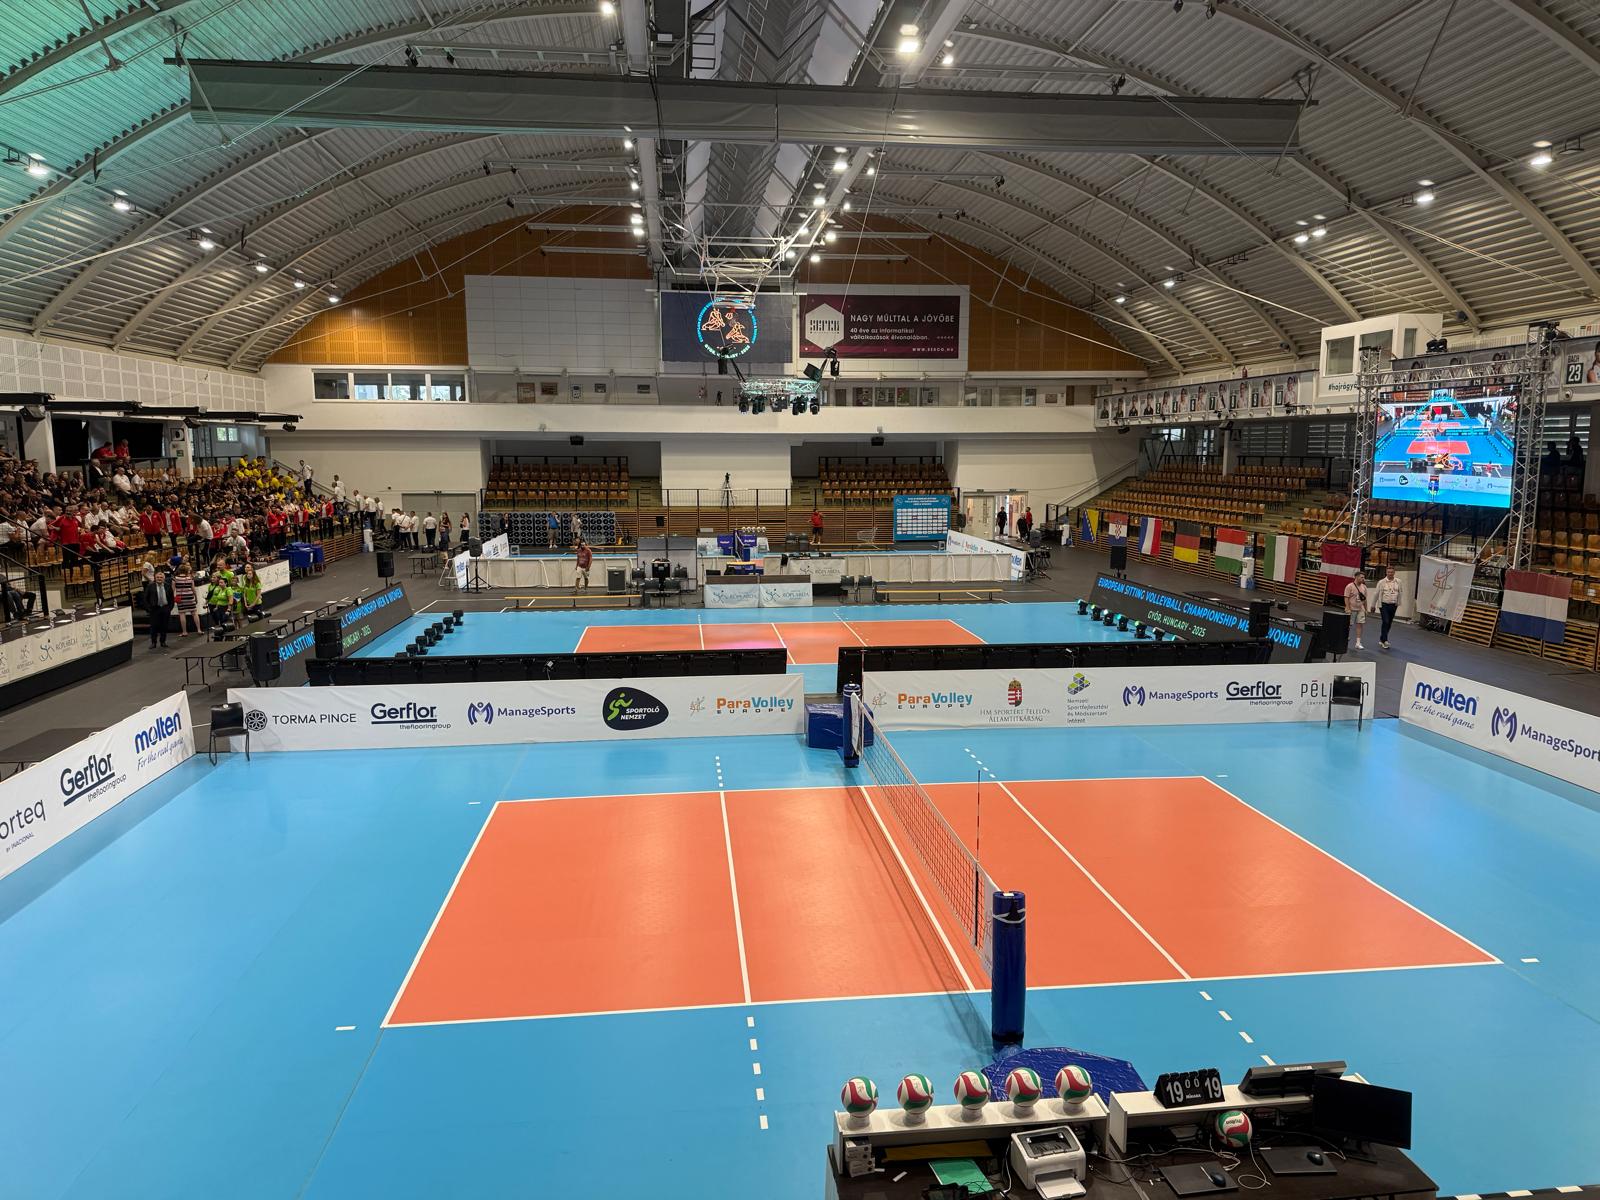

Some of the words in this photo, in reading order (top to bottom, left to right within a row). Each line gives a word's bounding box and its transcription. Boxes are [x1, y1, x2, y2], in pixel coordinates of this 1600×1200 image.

[850, 314, 873, 322] NAGY
[876, 313, 910, 322] MÚLTTAL
[850, 333, 890, 341] vállalkozások
[1568, 364, 1582, 382] 23
[1098, 577, 1125, 593] EUROPEAN
[1124, 585, 1146, 600] SITTING
[1145, 591, 1182, 612] VOLLEYBALL
[1183, 602, 1238, 629] CHAMPIONSHIP
[1238, 615, 1250, 633] ME
[1162, 615, 1190, 631] HUNGARY
[1191, 625, 1207, 638] 2025
[897, 692, 973, 705] ParaVolley
[1149, 690, 1219, 701] ManageSports
[1226, 681, 1282, 698] Gerflor
[716, 696, 793, 710] ParaVolley
[1415, 682, 1478, 716] molten
[272, 714, 317, 725] TORMA
[320, 713, 357, 724] PINCE
[371, 702, 438, 721] Gerflor
[498, 705, 576, 718] ManageSports
[626, 706, 660, 715] SPORTOLÓ
[1411, 700, 1425, 713] For
[1423, 703, 1436, 716] the
[1436, 709, 1453, 722] real
[1452, 714, 1475, 731] game
[134, 712, 182, 754] molten
[137, 758, 147, 771] For
[147, 752, 157, 766] the
[156, 744, 169, 762] real
[169, 738, 184, 756] game
[60, 753, 112, 797] Gerflor
[88, 774, 127, 803] theflooringroup
[1167, 1081, 1184, 1104] 19
[1205, 1076, 1222, 1099] 19
